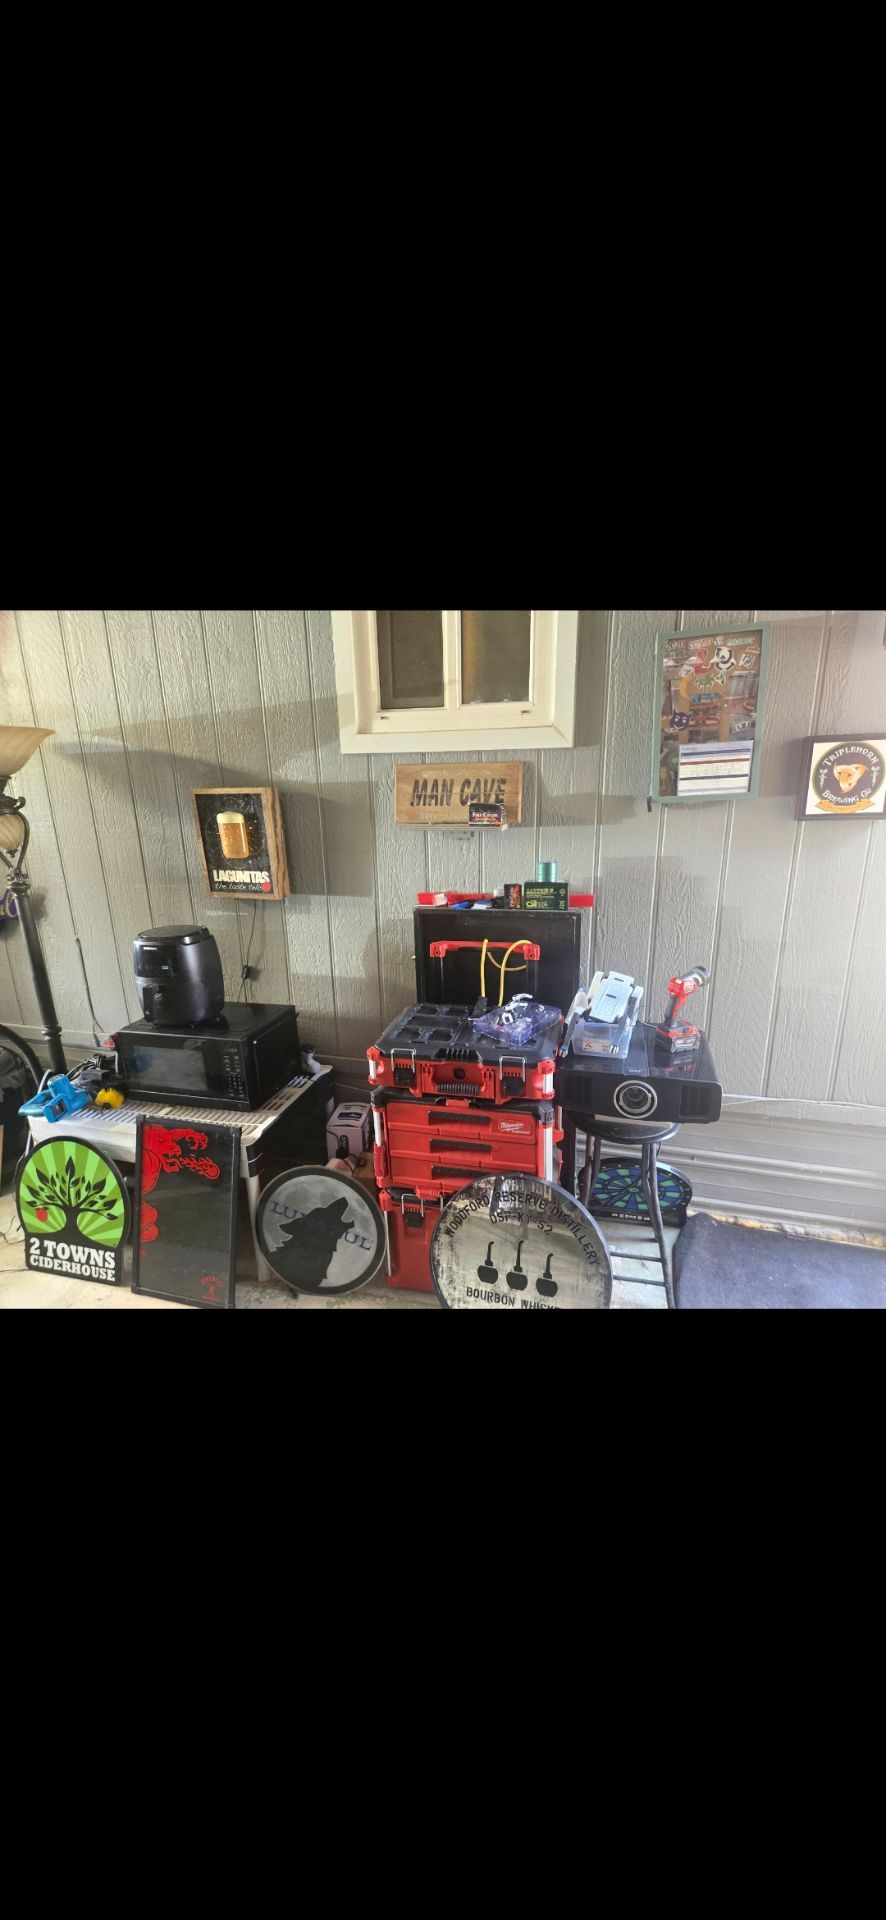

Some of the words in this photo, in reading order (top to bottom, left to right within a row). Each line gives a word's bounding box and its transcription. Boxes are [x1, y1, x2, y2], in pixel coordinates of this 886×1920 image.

[823, 746, 879, 767] TRIPLEHORN
[410, 778, 454, 806] MAN
[459, 778, 507, 806] CAVE
[822, 789, 860, 804] BREWING
[213, 869, 270, 884] LAGUNITAS
[215, 882, 227, 890] the
[228, 883, 247, 891] taste
[444, 1195, 490, 1238] WOODFORD
[495, 1190, 546, 1210] RESERVE
[551, 1205, 600, 1265] DISTILLERY
[30, 1237, 40, 1255] 2
[44, 1239, 115, 1269] TOWNS
[30, 1254, 116, 1282] CIDERHOUSE
[466, 1286, 515, 1307] BOURBON
